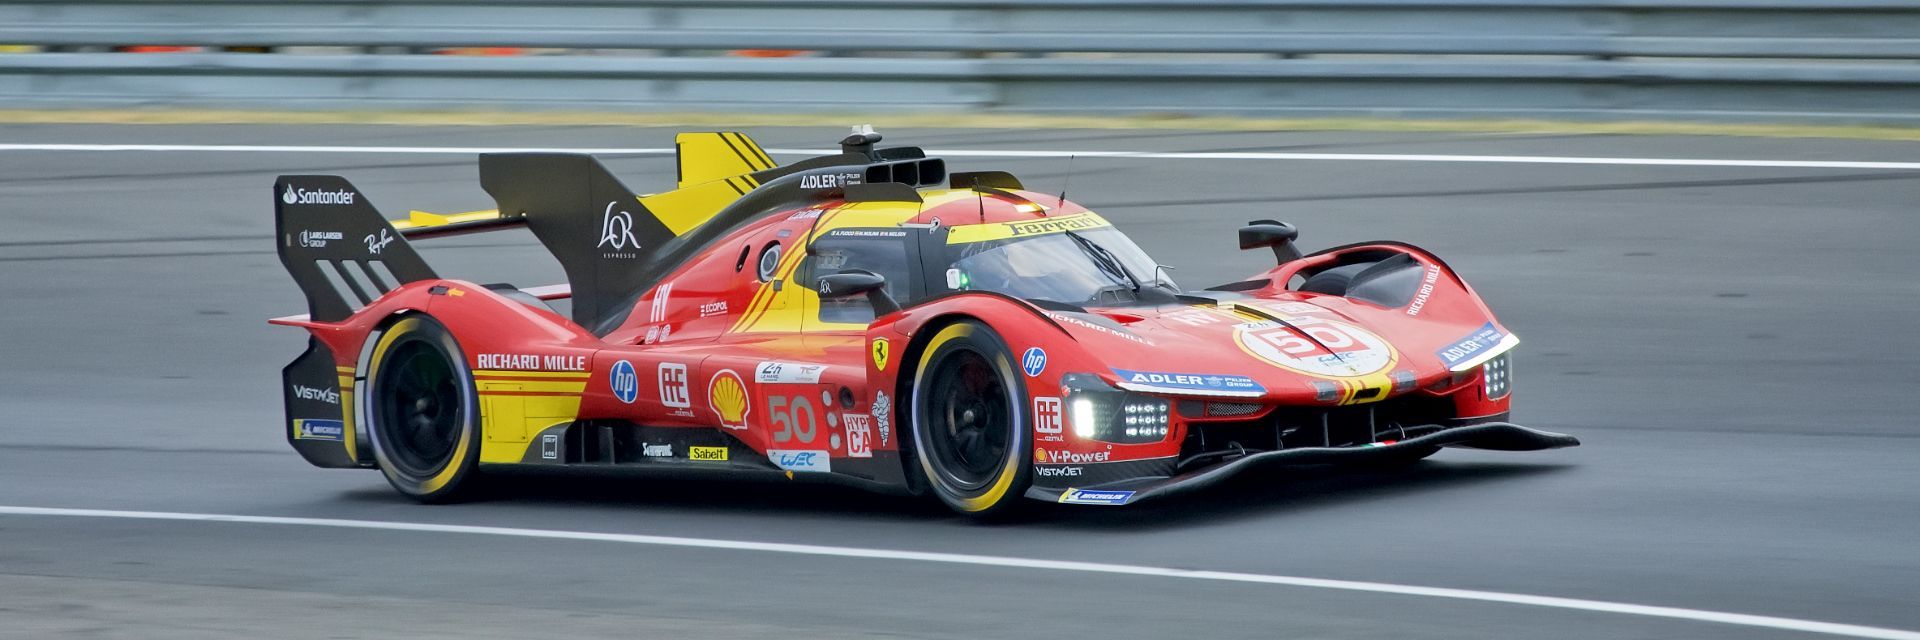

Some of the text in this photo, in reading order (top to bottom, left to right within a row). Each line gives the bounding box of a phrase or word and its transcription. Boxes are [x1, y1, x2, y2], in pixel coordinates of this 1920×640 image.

[800, 174, 836, 188] ADLER
[298, 188, 354, 204] Santander
[1001, 213, 1101, 237] Ferrari
[309, 240, 326, 248] GROUP
[1407, 264, 1441, 316] RICHARD MILLE
[706, 301, 727, 313] ECOPOL
[1111, 330, 1157, 347] MILLE
[1260, 326, 1354, 354] 50
[1440, 338, 1483, 363] ADLER
[478, 353, 586, 371] RICHARD MILLE
[1025, 348, 1045, 376] hp
[615, 361, 634, 403] hp
[1131, 373, 1204, 385] ADLER
[293, 384, 340, 405] VISTAJET
[768, 395, 817, 443] 50
[693, 447, 724, 460] Sabelt
[780, 452, 816, 466] WEC
[1048, 450, 1111, 463] V-Power
[1035, 466, 1083, 476] VISTAJET
